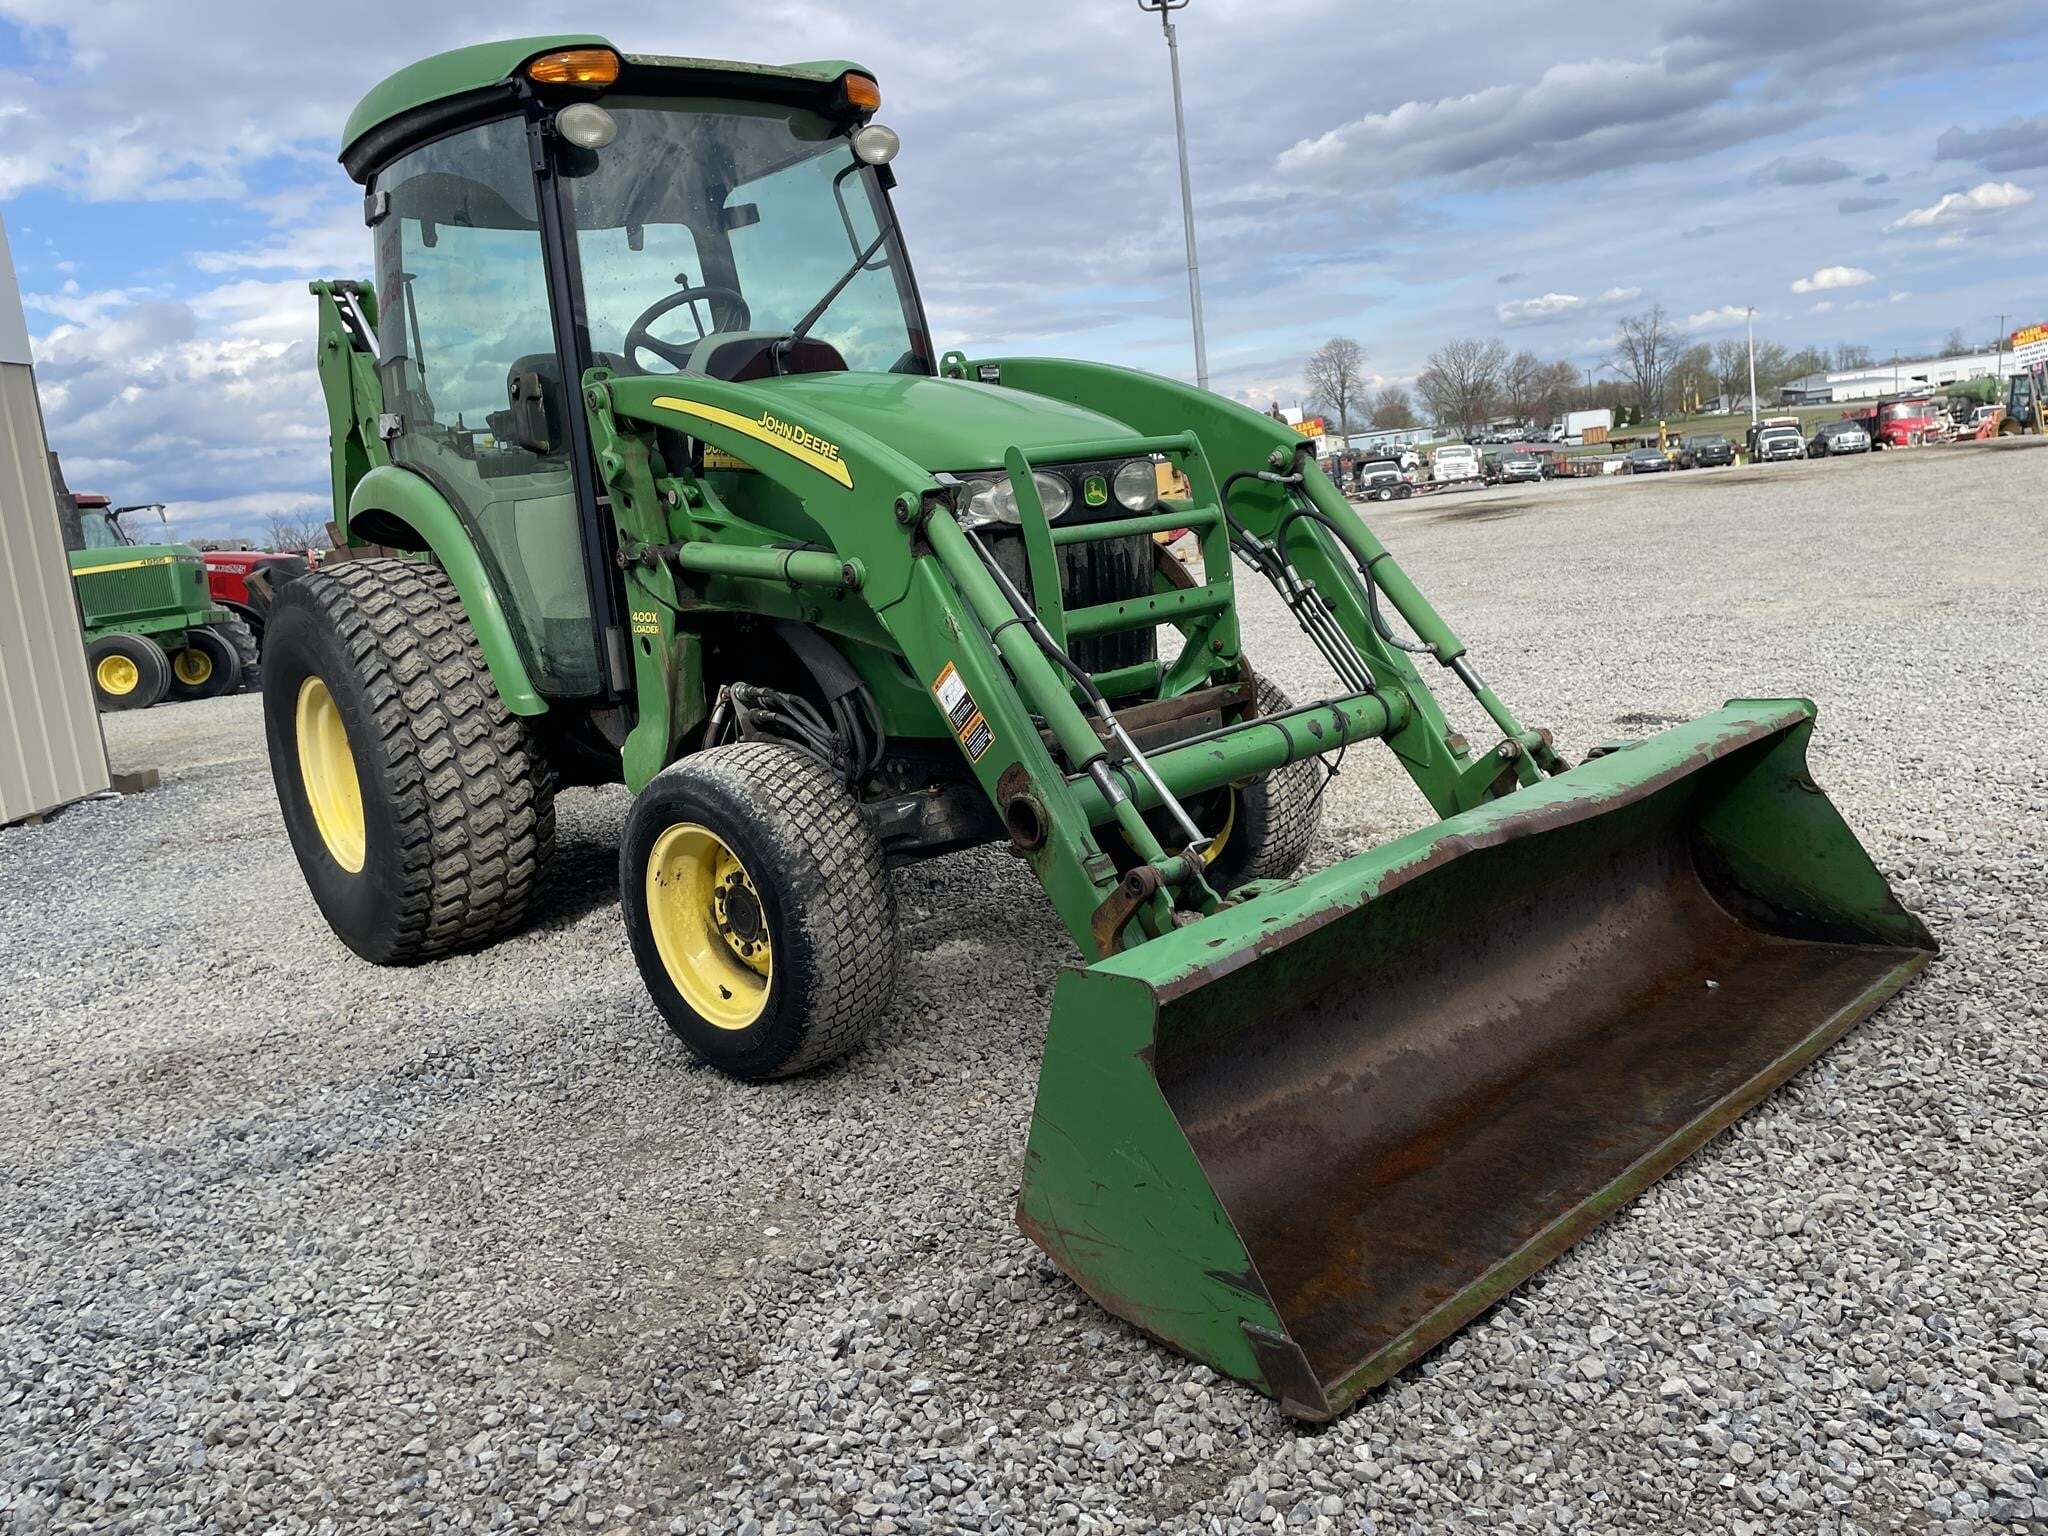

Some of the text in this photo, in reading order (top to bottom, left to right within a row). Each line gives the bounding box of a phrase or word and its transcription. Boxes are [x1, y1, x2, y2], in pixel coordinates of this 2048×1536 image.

[757, 411, 840, 461] JOHN DEERE
[632, 611, 658, 623] 400X
[633, 625, 660, 634] LOADER
